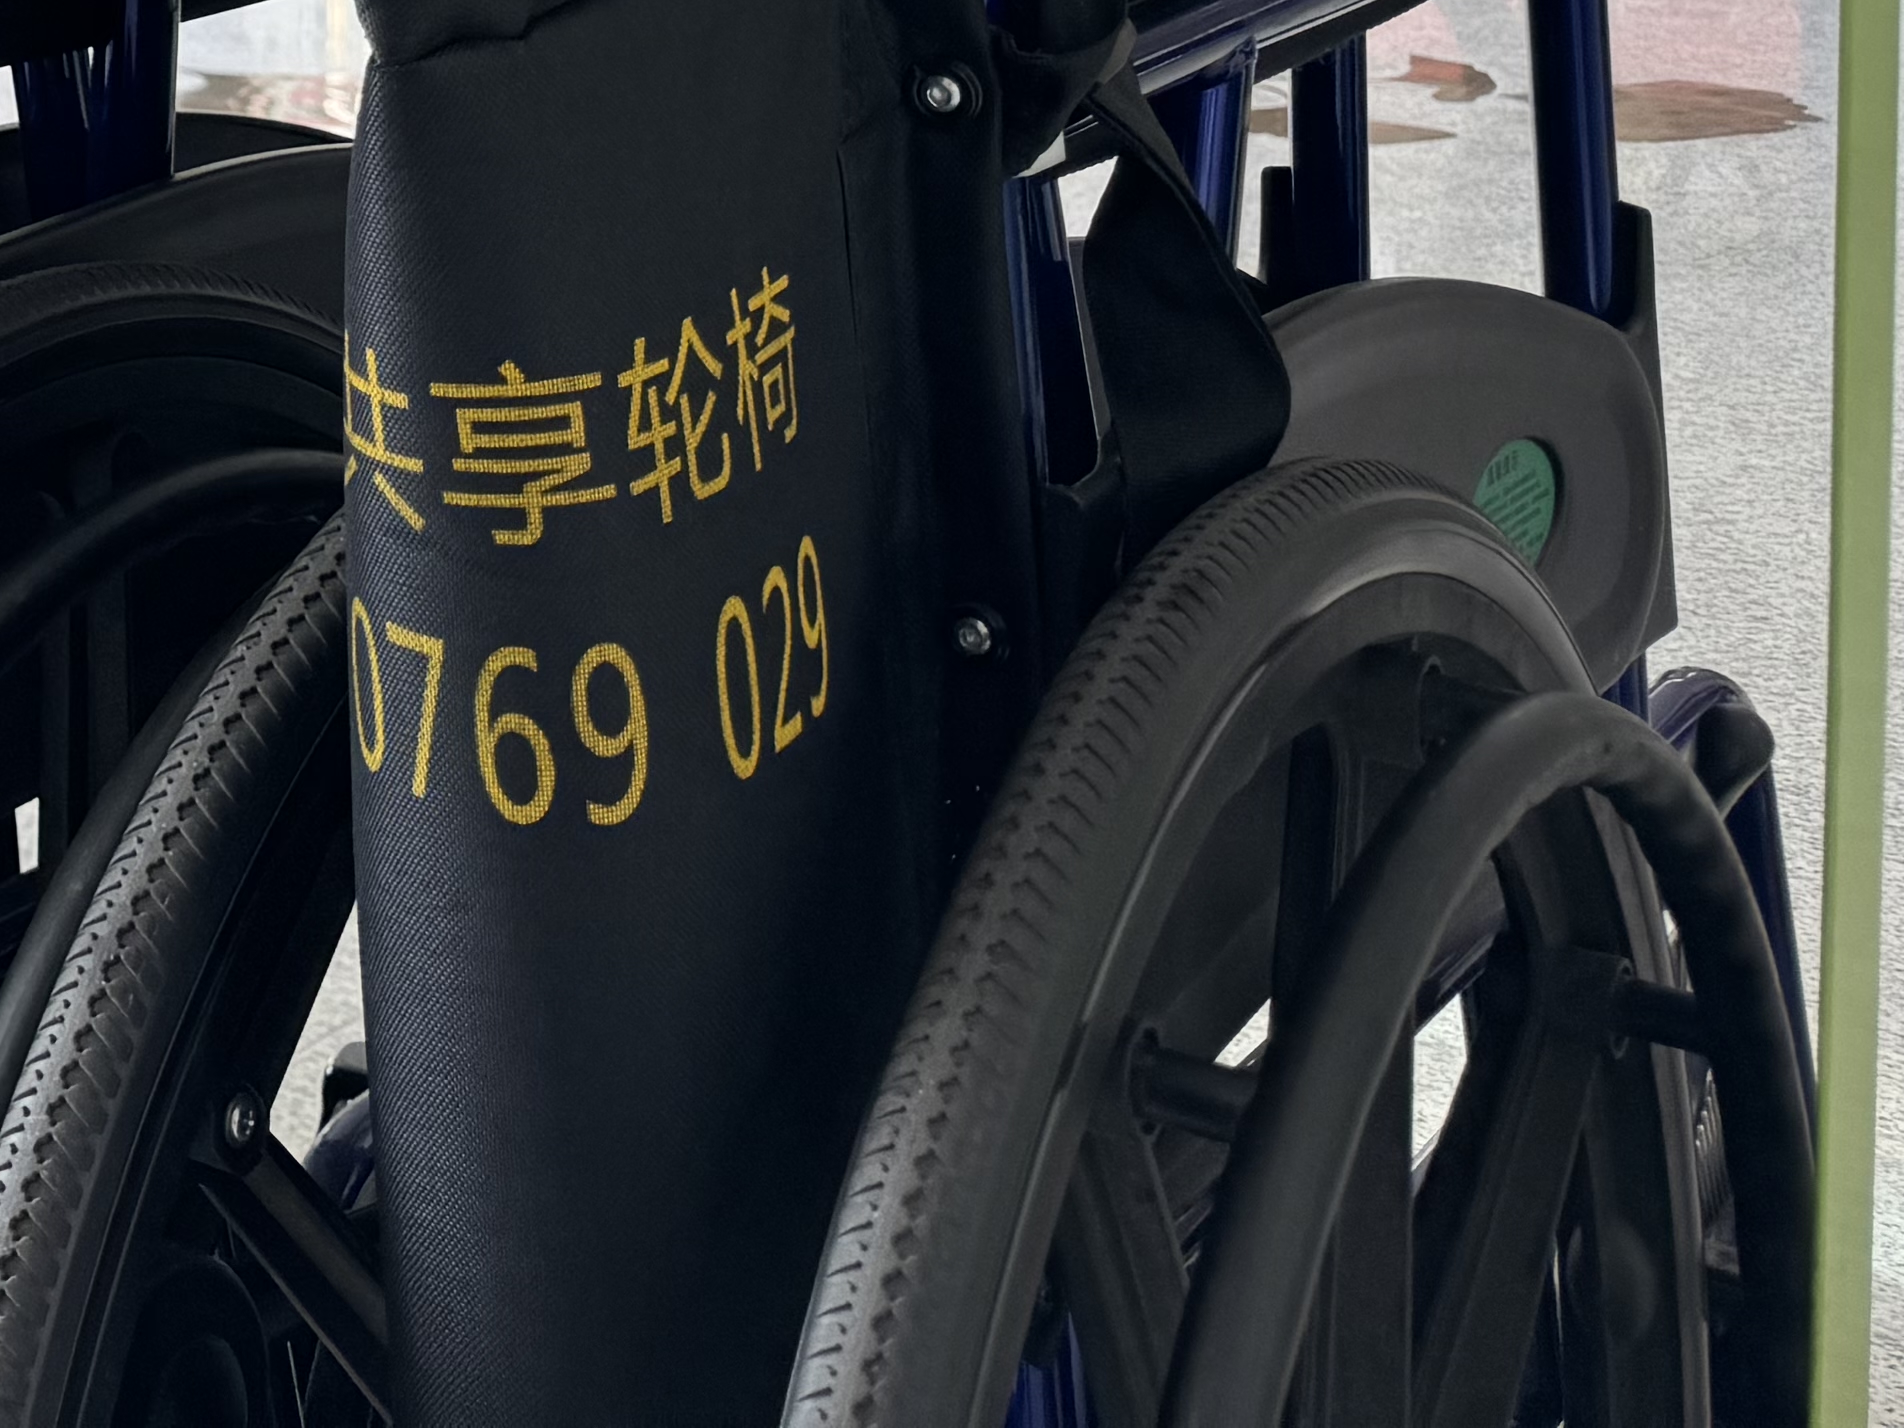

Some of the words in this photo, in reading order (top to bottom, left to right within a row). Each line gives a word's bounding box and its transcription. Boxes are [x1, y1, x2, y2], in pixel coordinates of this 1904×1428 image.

[343, 265, 797, 546] 共享轮椅
[350, 595, 649, 826] 0769
[715, 534, 829, 780] 029
